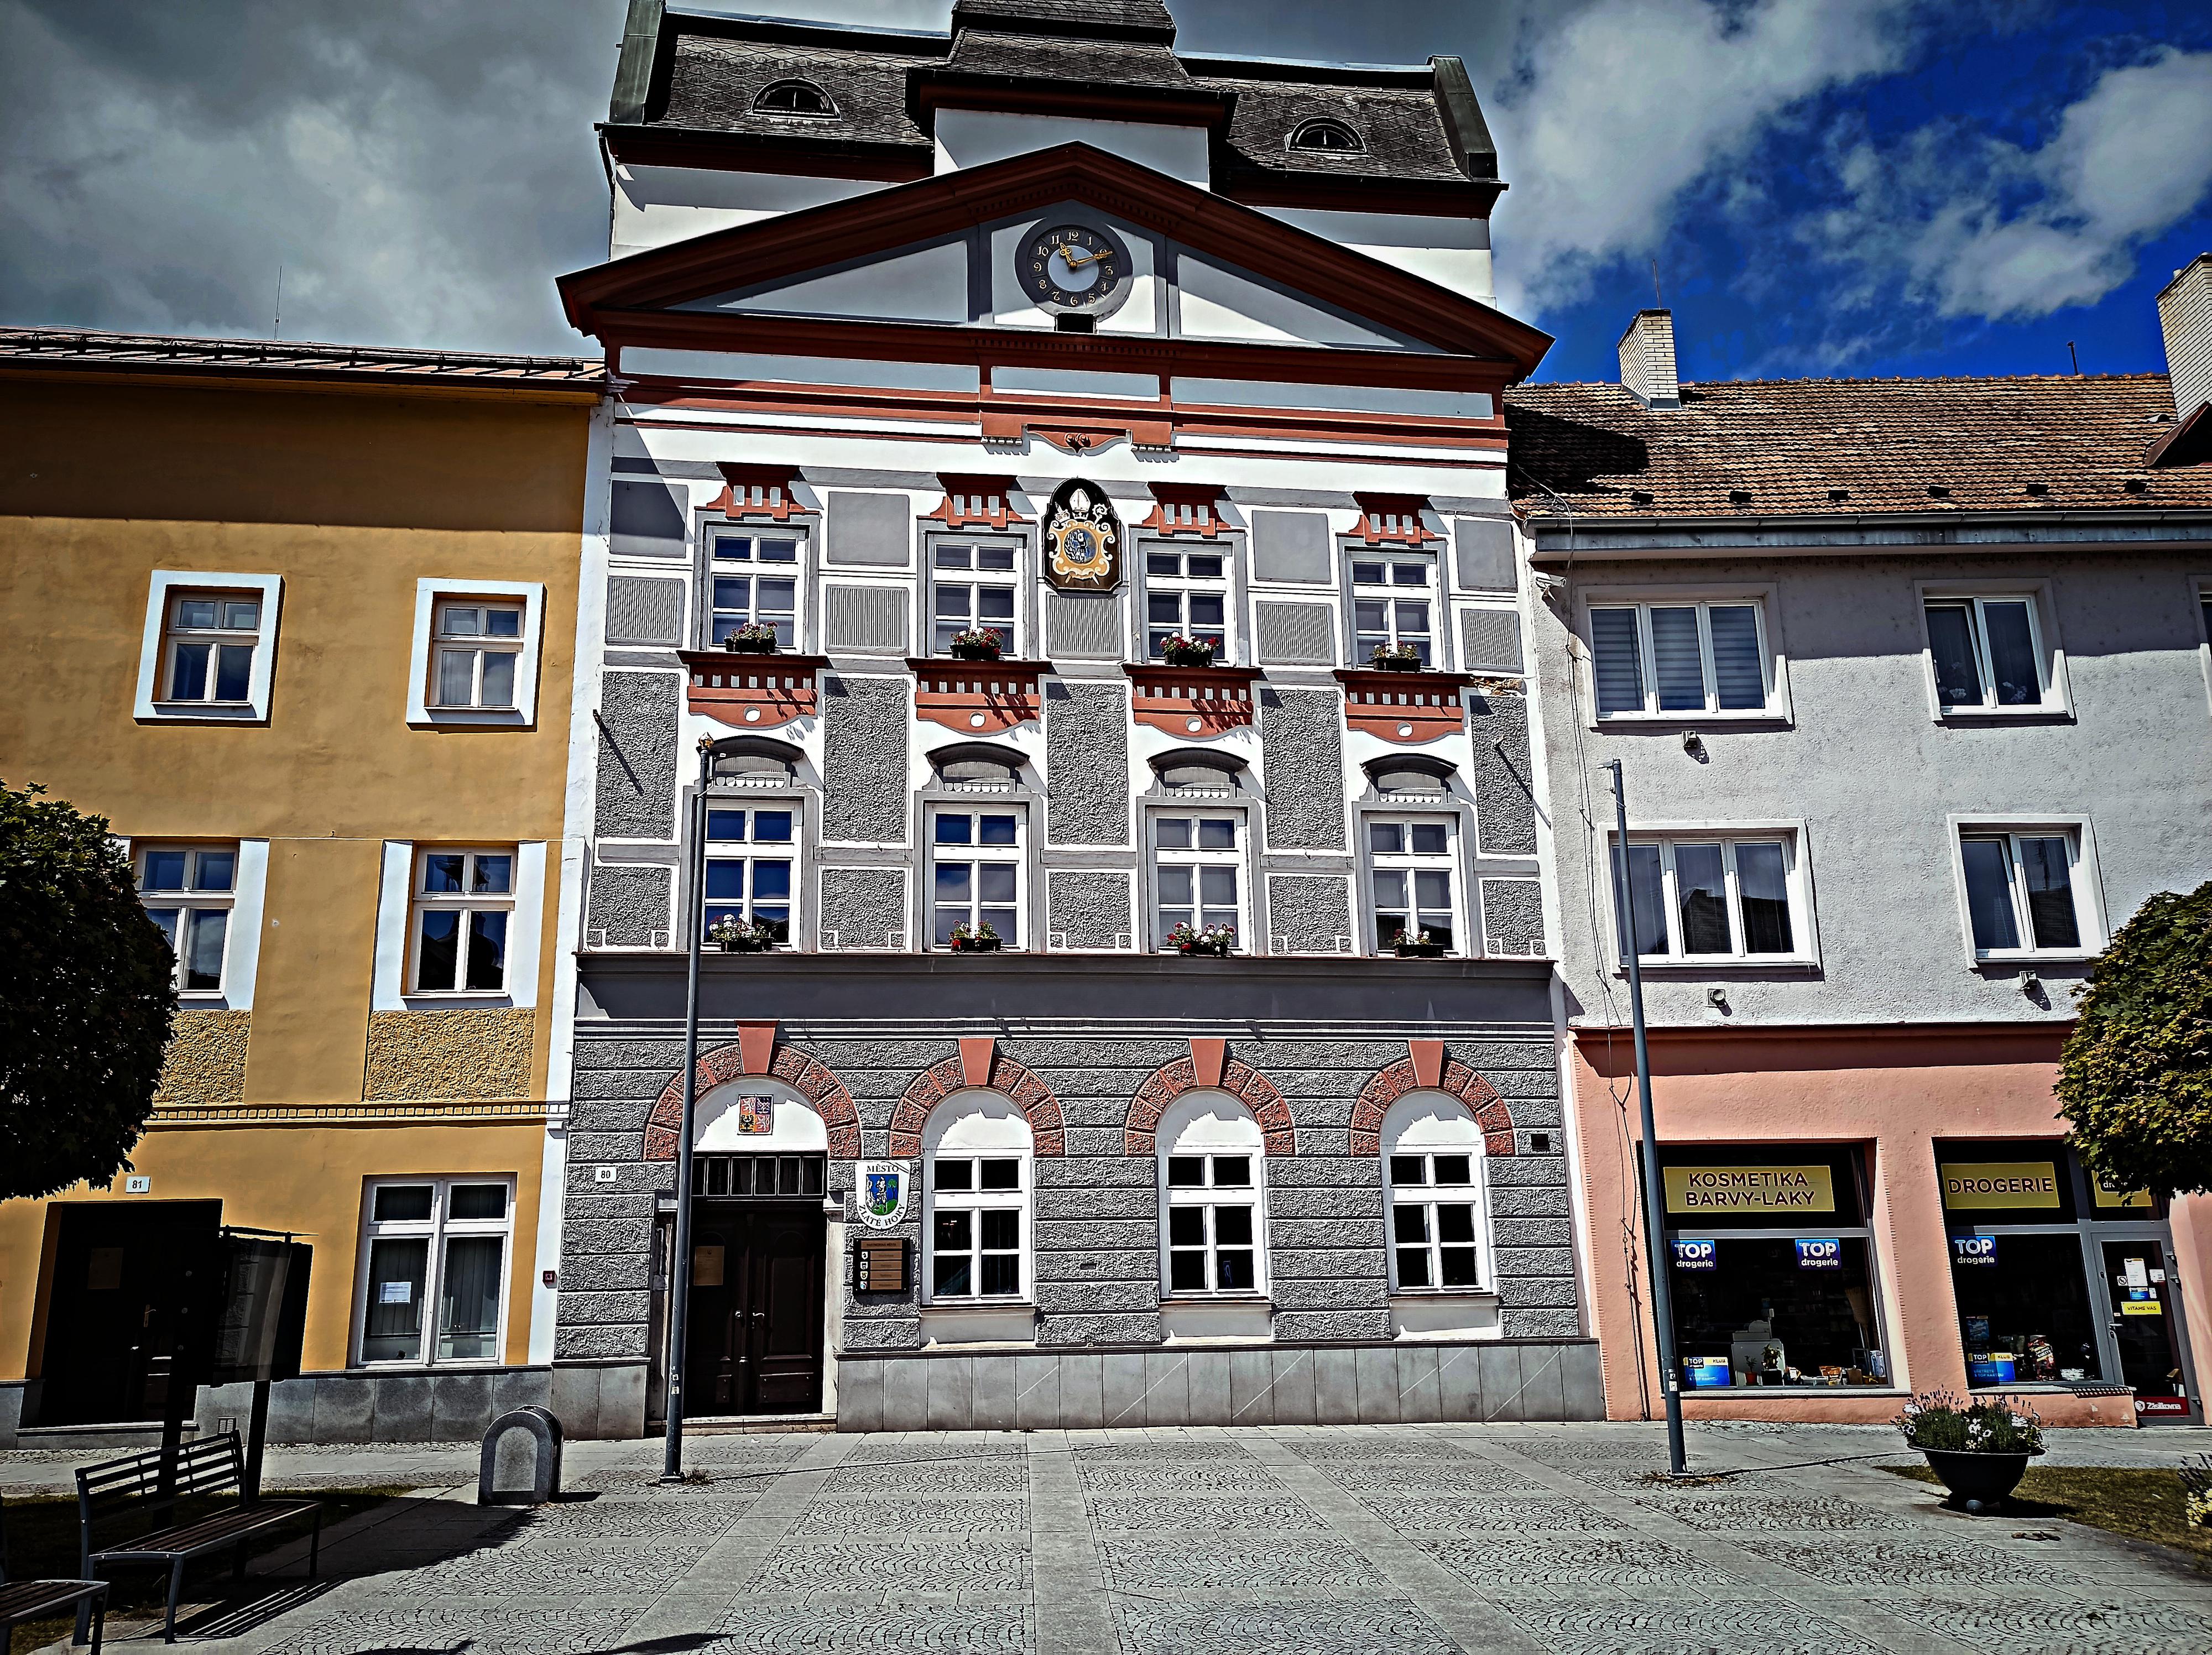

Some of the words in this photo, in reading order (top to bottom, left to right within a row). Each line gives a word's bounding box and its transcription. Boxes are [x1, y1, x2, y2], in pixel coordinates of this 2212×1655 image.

[1051, 234, 1060, 244] 11
[1067, 231, 1079, 241] 12
[1088, 236, 1092, 246] 1
[1037, 246, 1048, 257] 10
[1034, 262, 1042, 272] 9
[1105, 265, 1113, 276] 3
[1039, 279, 1046, 289] 8
[1052, 291, 1060, 301] 7
[1070, 296, 1078, 306] 6
[1088, 293, 1096, 304] 5
[867, 1163, 899, 1172] MĚSTO
[601, 1170, 611, 1179] 80
[1689, 1172, 1808, 1187] KOSMETIKA
[132, 1179, 142, 1189] 81
[1948, 1177, 2054, 1194] DROGERIE
[1686, 1191, 1815, 1207] BARVY-LAKY
[859, 1204, 881, 1226] ZLATÉ
[884, 1203, 905, 1226] HORY
[1674, 1242, 1712, 1259] TOP
[1799, 1242, 1837, 1257] TOP
[1955, 1239, 1993, 1255] TOP
[1676, 1259, 1714, 1268] drogerie
[1801, 1257, 1838, 1267] drogerie
[1957, 1255, 1995, 1265] drogerie
